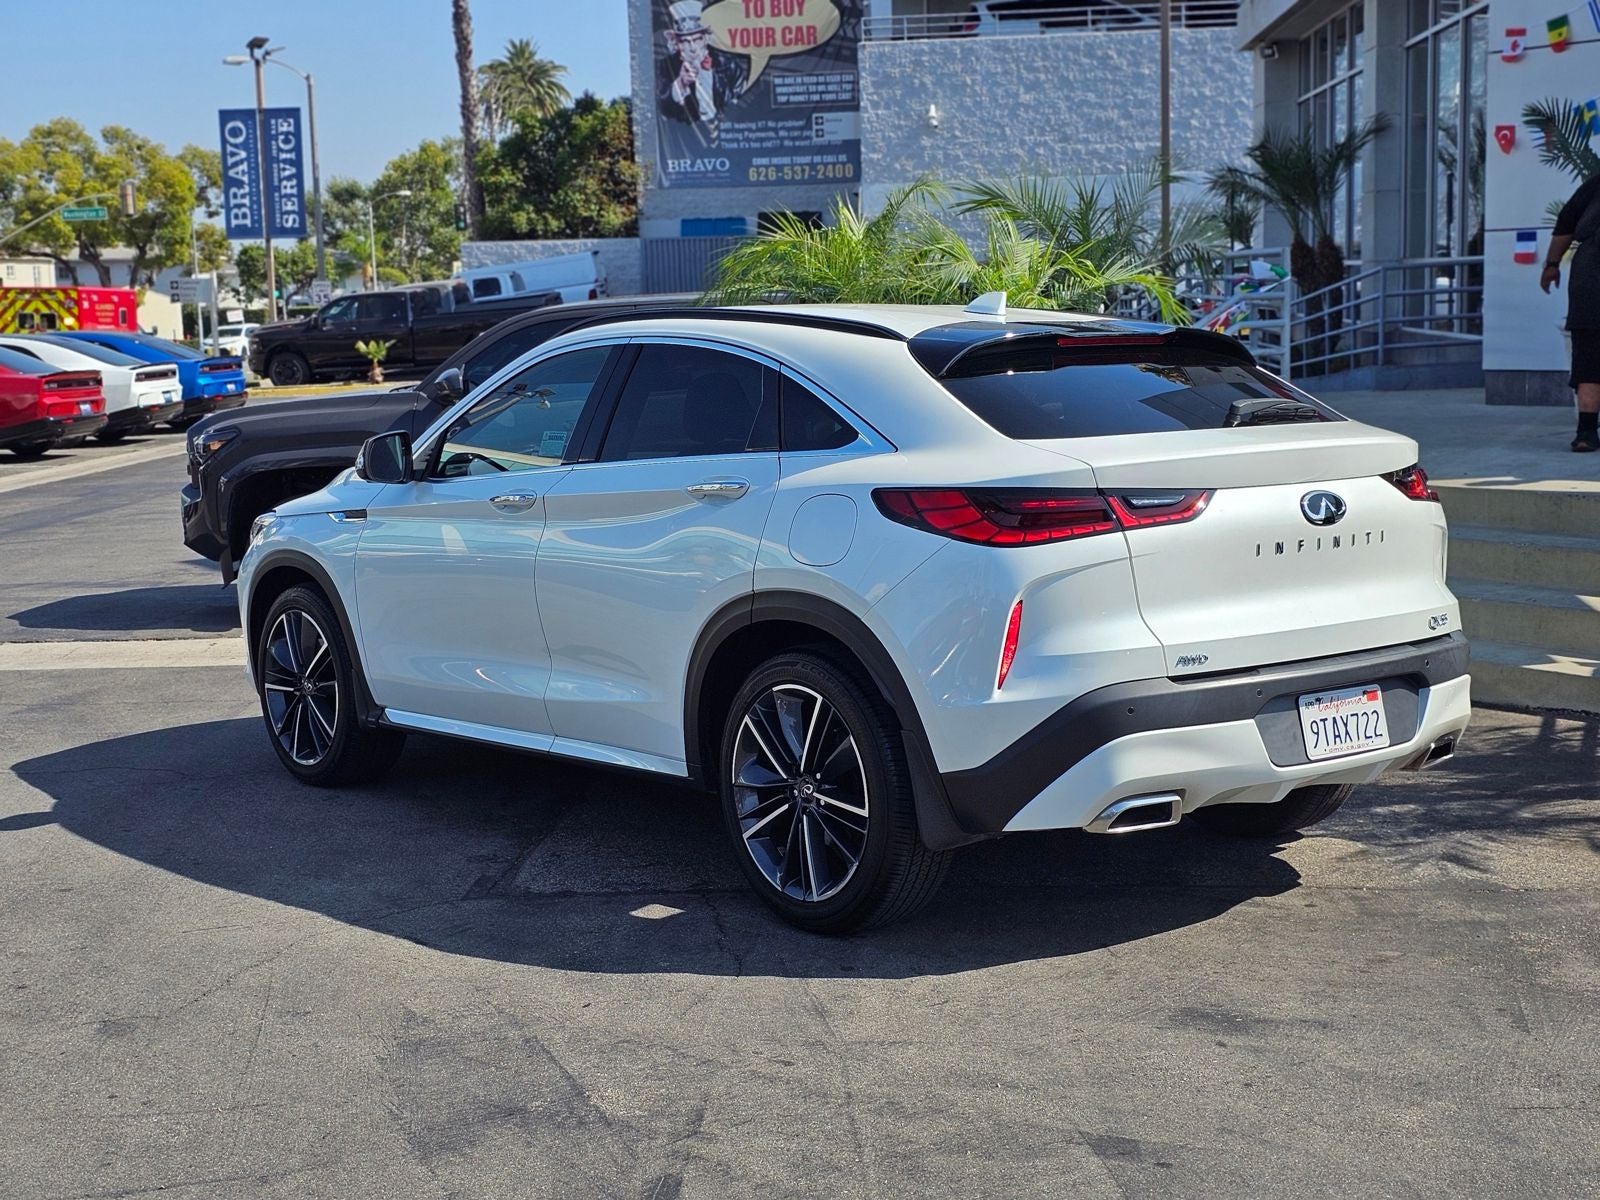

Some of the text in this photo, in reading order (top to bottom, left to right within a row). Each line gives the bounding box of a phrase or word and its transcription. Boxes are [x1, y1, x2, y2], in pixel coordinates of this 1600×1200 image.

[742, 0, 806, 18] TO BUY
[728, 25, 817, 48] YOUR CAR
[720, 131, 743, 140] Making
[277, 118, 300, 229] SERVICE
[667, 157, 730, 172] BRAVO
[748, 163, 854, 181] 626-537-2400
[224, 120, 252, 229] BRAVO
[315, 293, 331, 303] 35
[1256, 529, 1385, 557] INFINITI
[1174, 654, 1209, 668] AWD
[1318, 696, 1363, 713] California
[1310, 709, 1383, 750] 9TAX722
[1328, 742, 1370, 753] dmv.ca.gov
